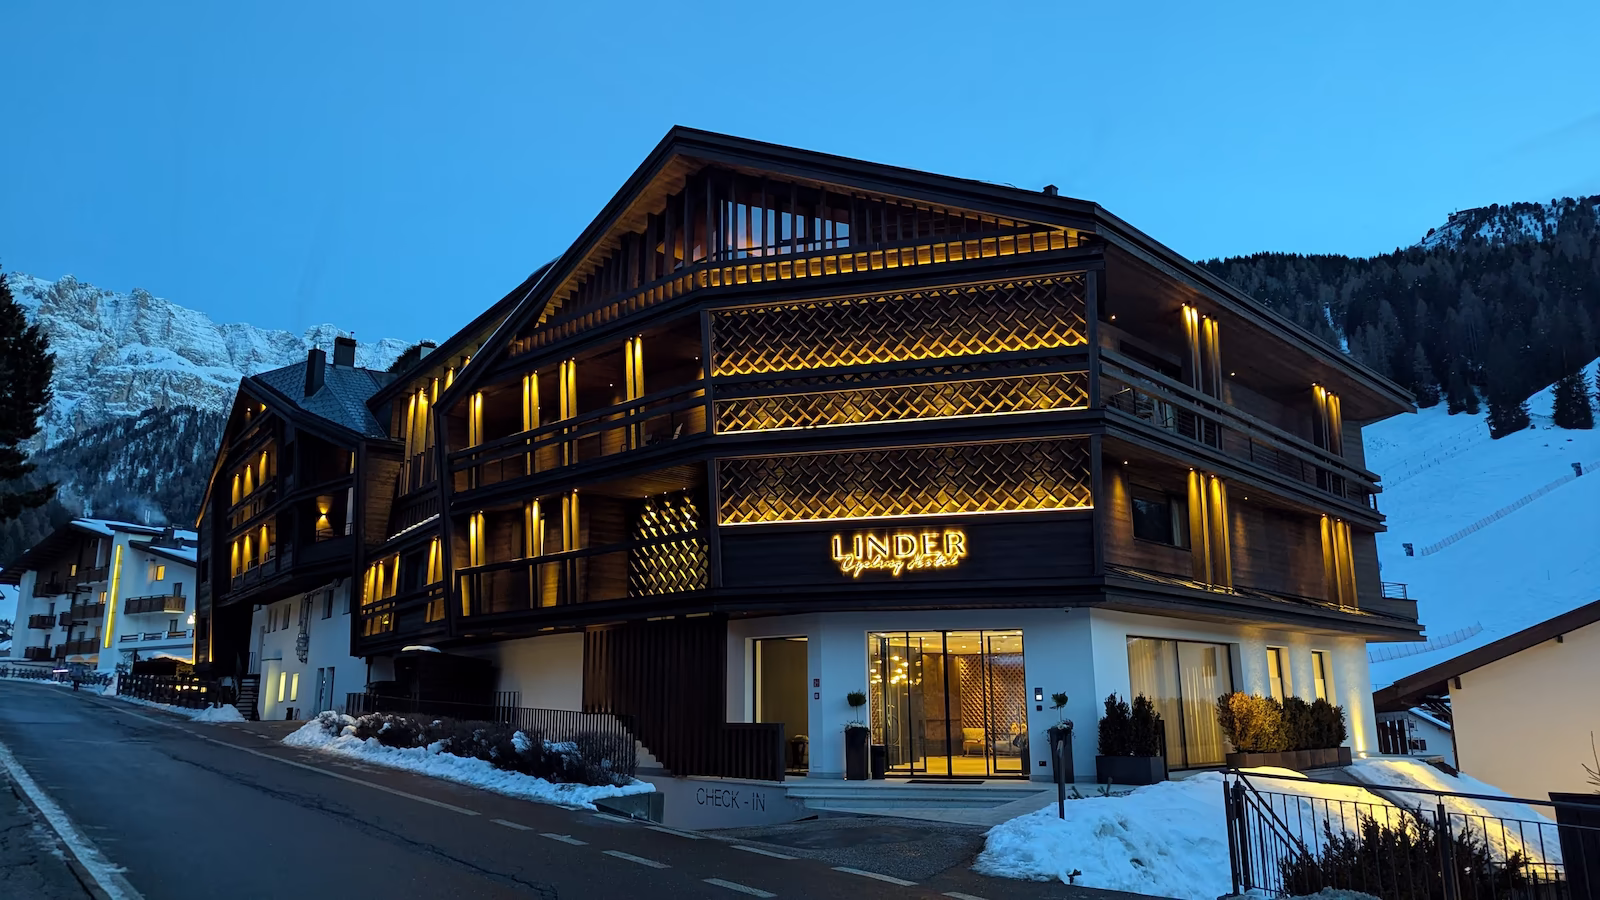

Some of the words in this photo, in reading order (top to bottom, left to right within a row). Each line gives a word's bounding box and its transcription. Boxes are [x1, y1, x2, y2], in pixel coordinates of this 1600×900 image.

[832, 531, 966, 561] LINDER
[841, 553, 904, 578] Cycling
[907, 553, 959, 570] Hotel
[696, 787, 740, 809] CHECK
[752, 792, 766, 812] IN
